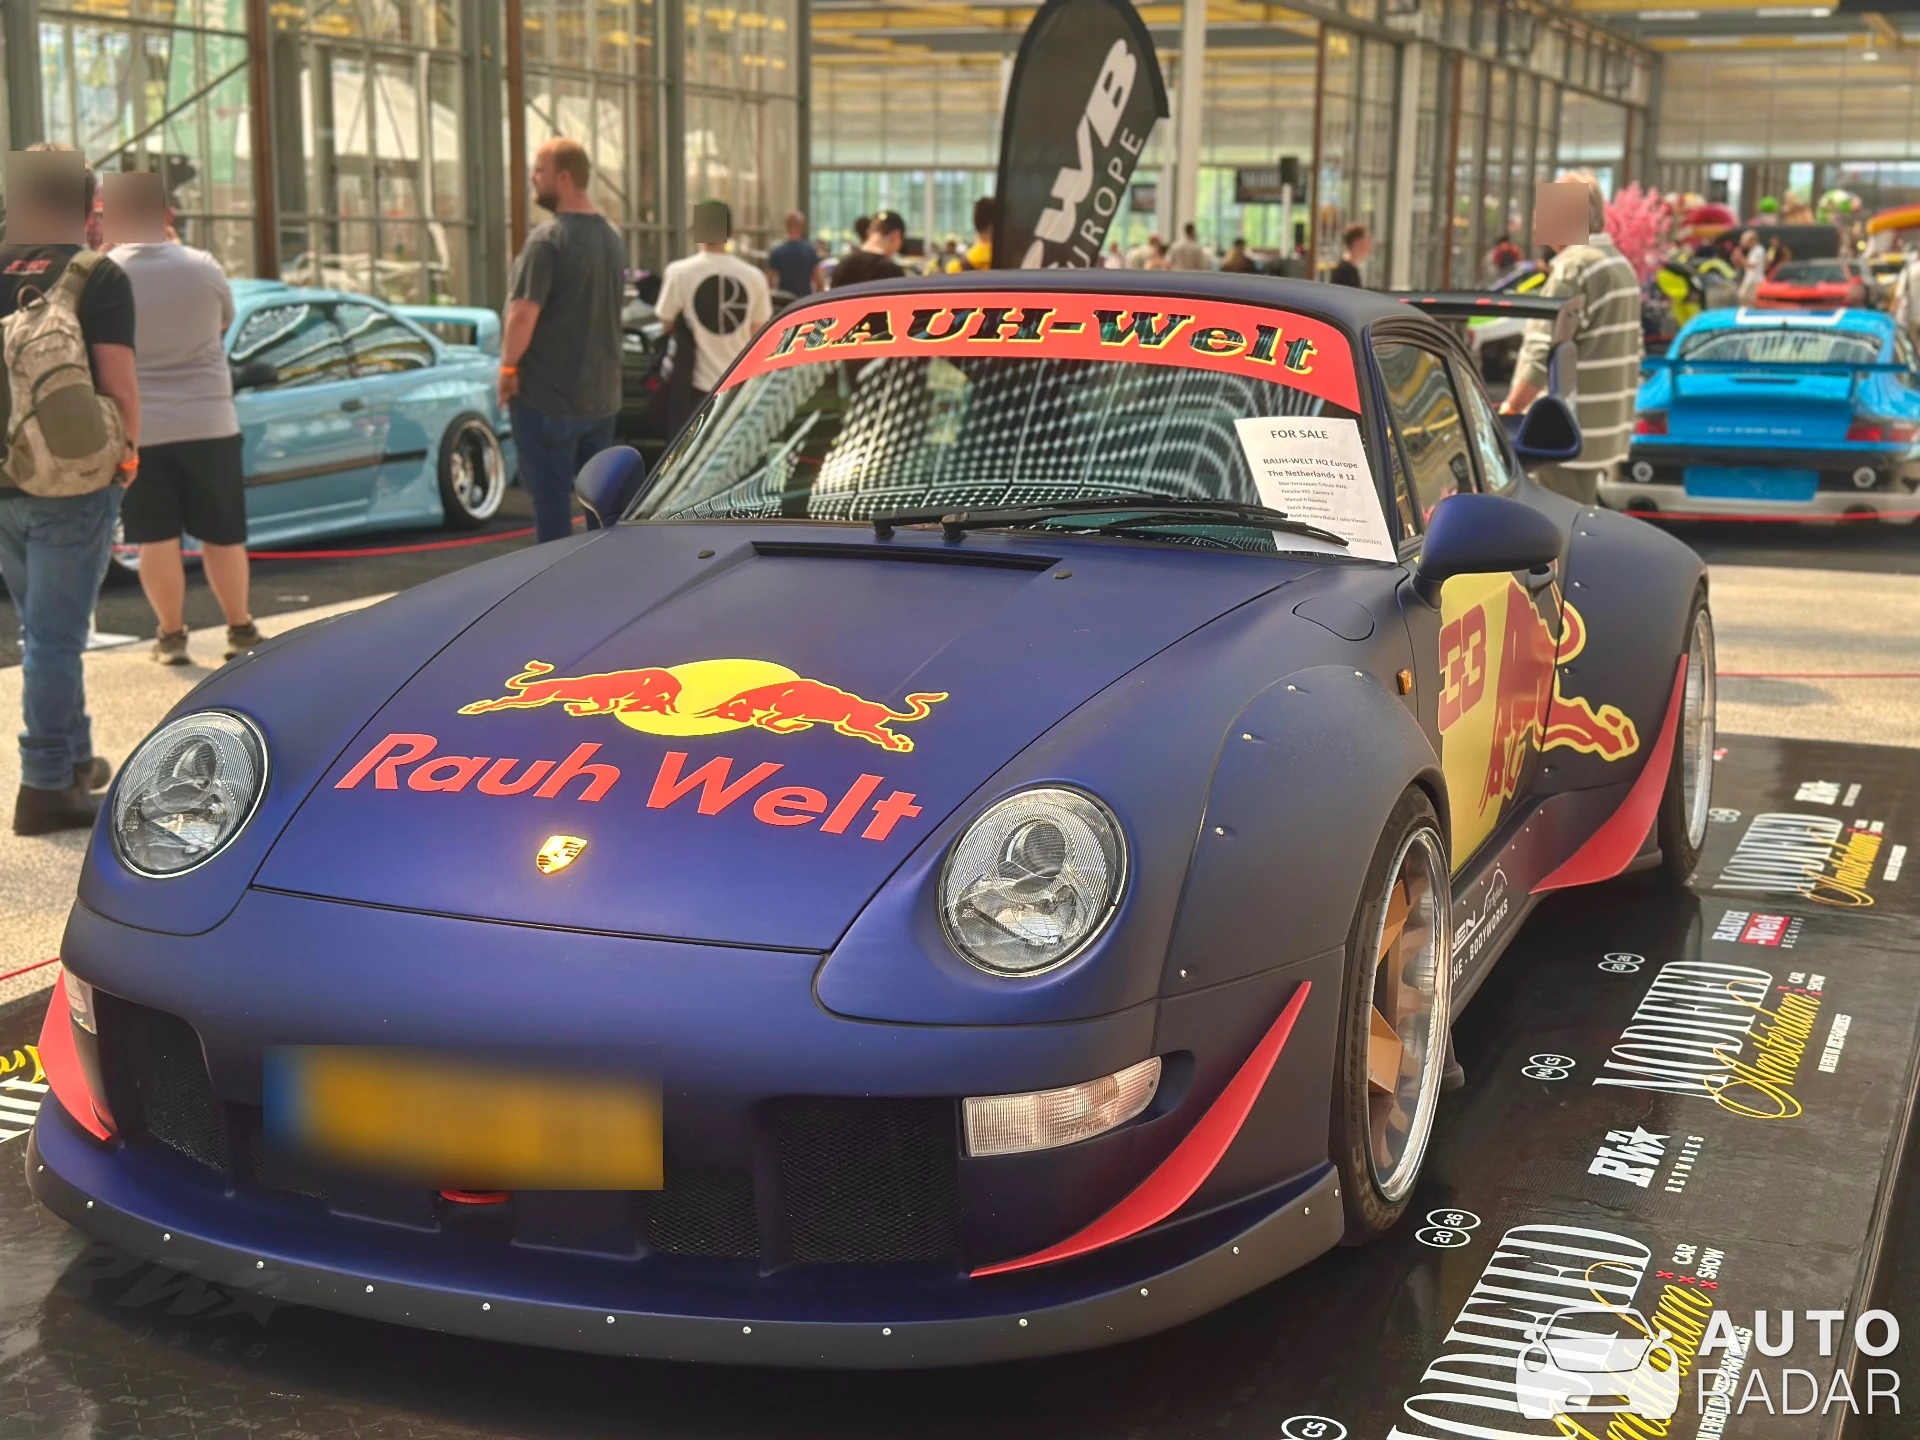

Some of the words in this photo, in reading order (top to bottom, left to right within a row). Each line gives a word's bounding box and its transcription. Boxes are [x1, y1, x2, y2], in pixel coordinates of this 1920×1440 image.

[1047, 127, 1143, 269] UROPE
[765, 307, 1318, 375] RAUH-Welt
[1270, 430, 1297, 438] FOR
[1299, 430, 1329, 439] SALE
[1263, 458, 1314, 466] RAUH-WELT
[1315, 459, 1329, 467] HQ
[1330, 460, 1358, 469] Europe
[1285, 470, 1336, 479] Netherlands
[334, 733, 621, 802] Rauh
[646, 751, 922, 841] Welt
[1469, 898, 1508, 961] BODYWORKS
[1592, 961, 1773, 1102] MODIFIED
[1704, 980, 1821, 1118] Amsterdam
[1672, 1243, 1698, 1265] CAR
[1696, 1247, 1724, 1279] SHOW
[1302, 1421, 1328, 1438] CS
